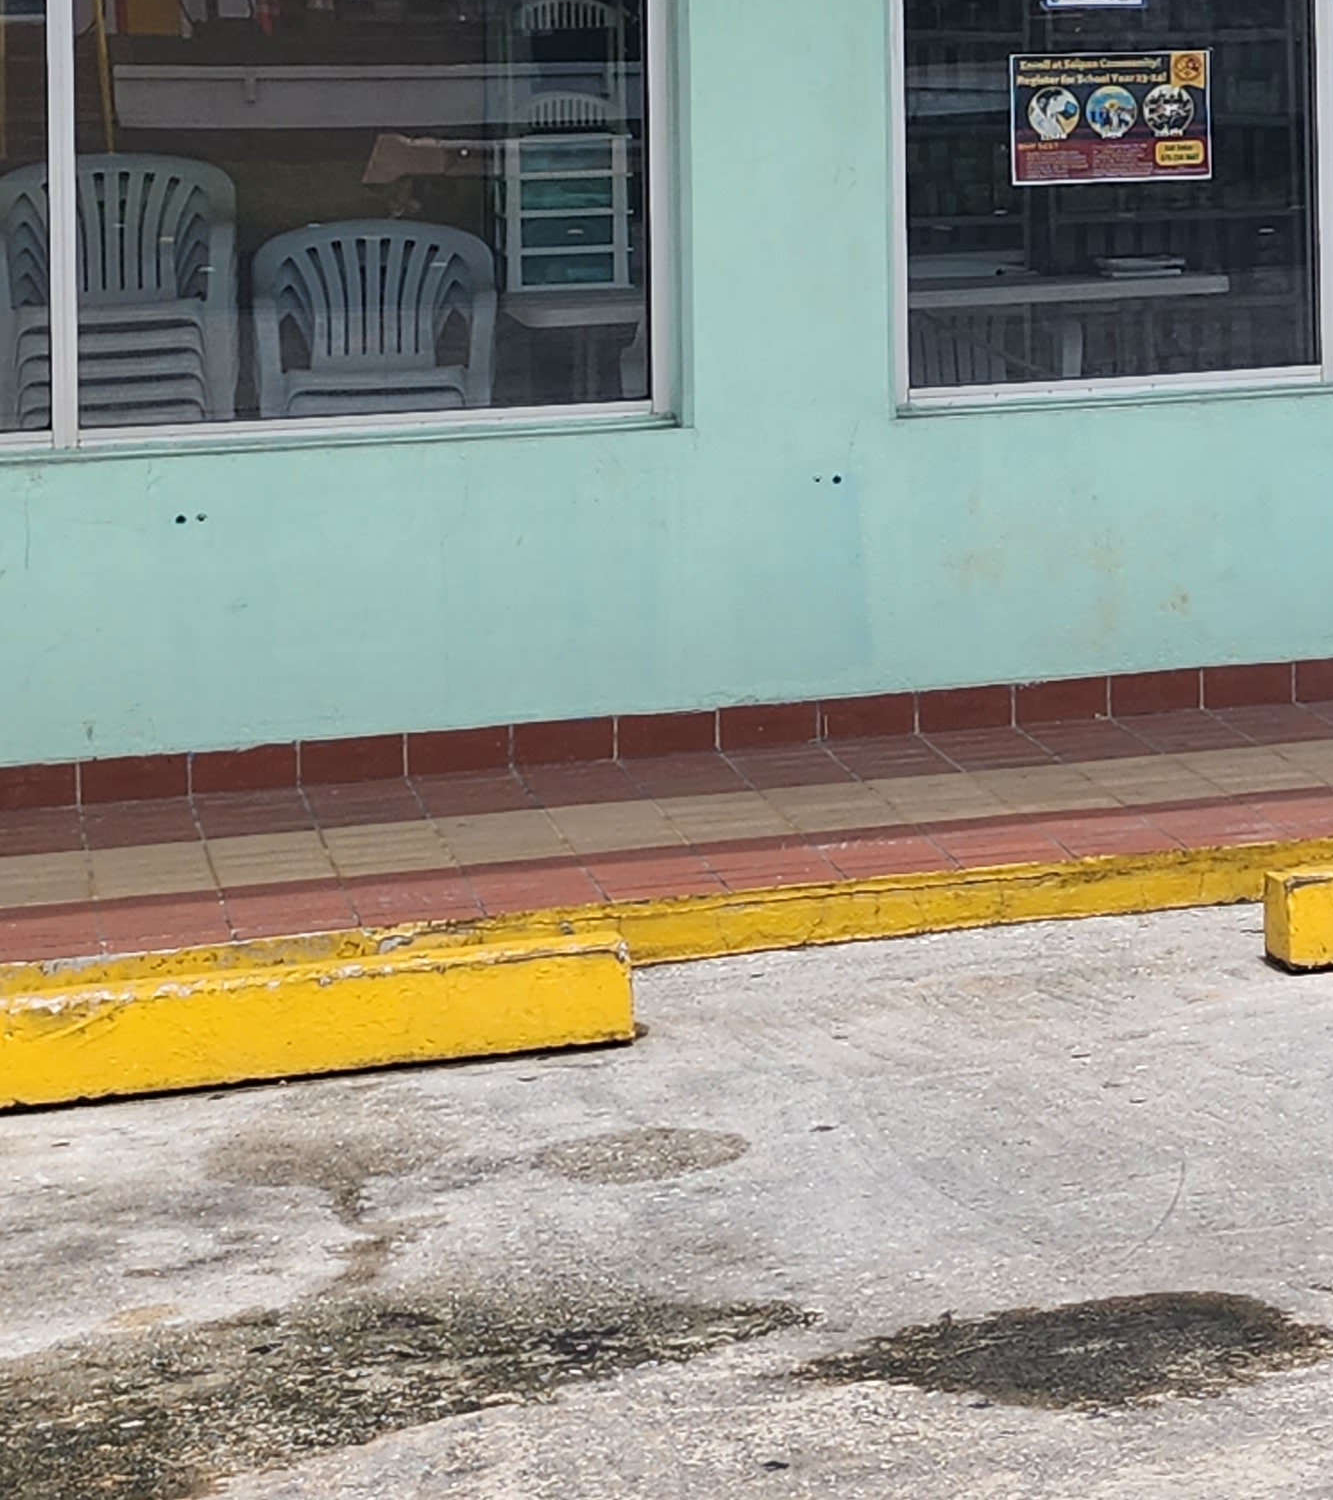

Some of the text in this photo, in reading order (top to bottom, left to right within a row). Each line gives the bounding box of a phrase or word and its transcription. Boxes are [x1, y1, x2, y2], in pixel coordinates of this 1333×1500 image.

[1019, 59, 1051, 71] Enroll
[1016, 74, 1059, 87] Register
[1077, 73, 1110, 84] School
